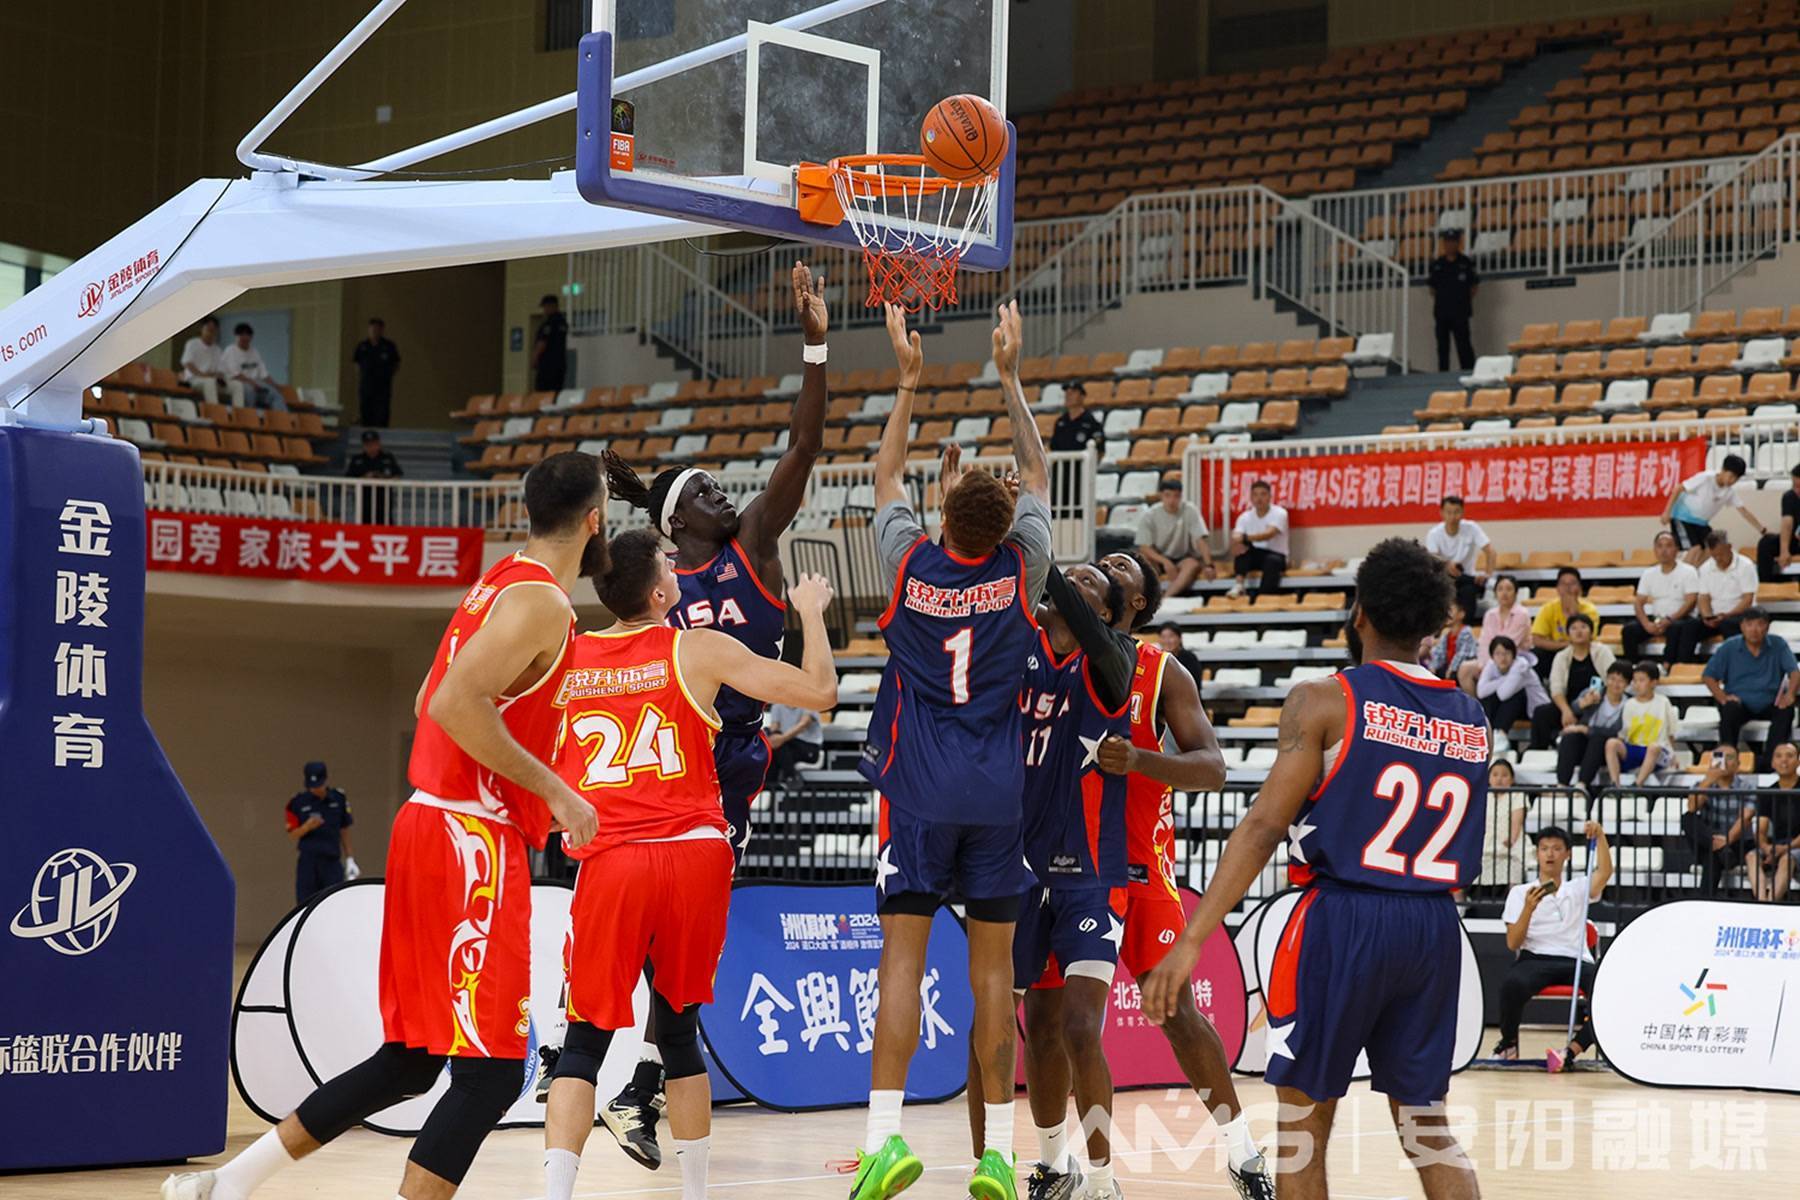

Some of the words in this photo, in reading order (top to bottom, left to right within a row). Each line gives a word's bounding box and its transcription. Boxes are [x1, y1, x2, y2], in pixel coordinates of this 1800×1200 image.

[613, 138, 630, 152] FIBA
[108, 249, 159, 292] 金陵体育
[151, 518, 221, 567] 园旁
[238, 527, 460, 577] 家族大平层
[53, 499, 112, 768] 金陵体育
[627, 678, 667, 693] SPORT
[943, 626, 973, 704] 1
[1363, 725, 1440, 756] RUISHENG
[1443, 744, 1488, 763] SPORT
[1364, 701, 1487, 749] 锐升体育
[571, 706, 687, 789] 24
[1361, 761, 1470, 882] 22
[849, 914, 880, 927] 2024
[1640, 1042, 1666, 1051] CHINA
[1669, 1044, 1703, 1053] SPORTS
[1705, 1045, 1744, 1055] LOTTERY
[1643, 1023, 1749, 1043] 中国体育彩票
